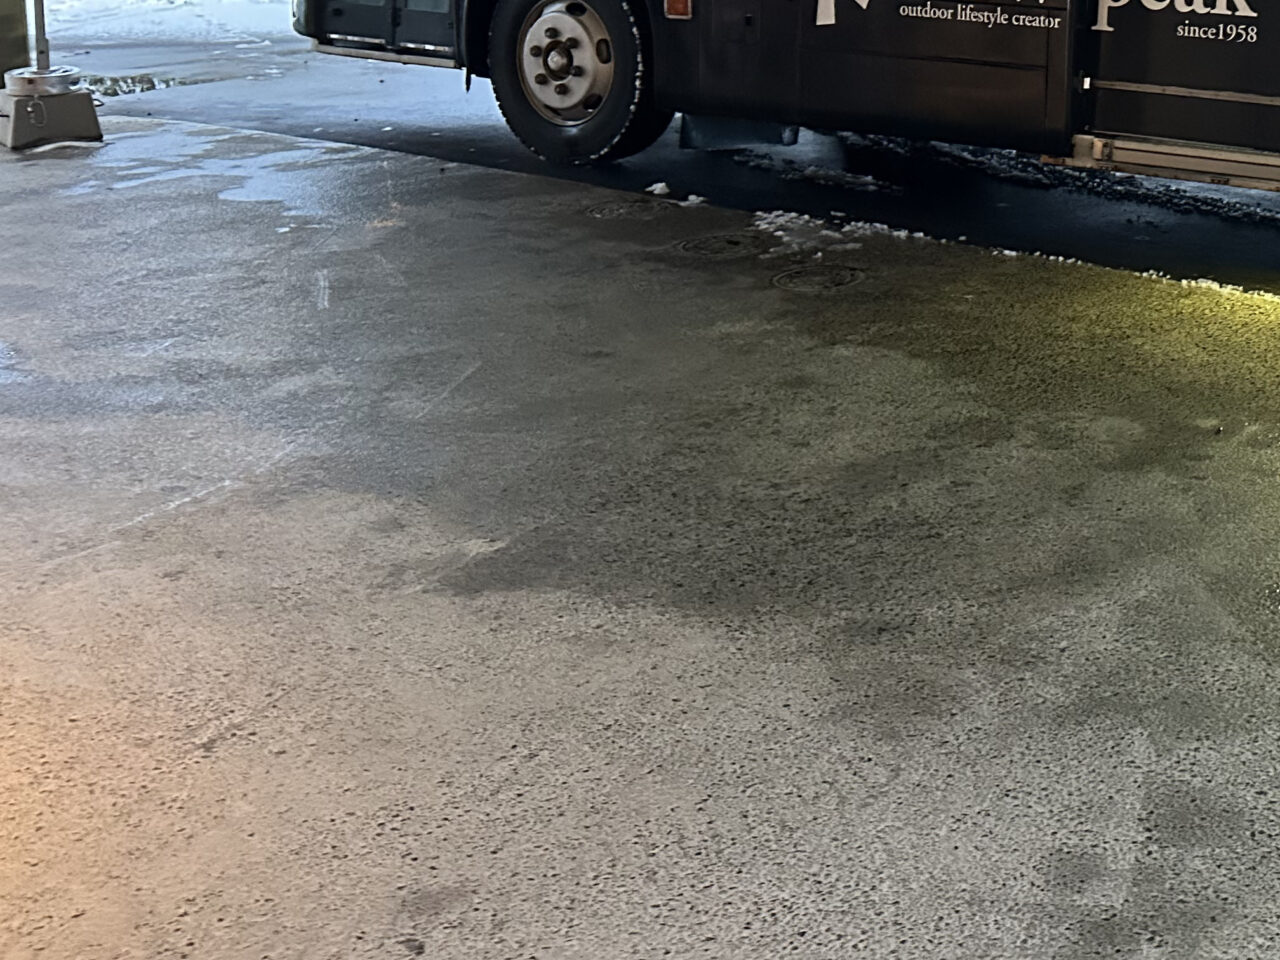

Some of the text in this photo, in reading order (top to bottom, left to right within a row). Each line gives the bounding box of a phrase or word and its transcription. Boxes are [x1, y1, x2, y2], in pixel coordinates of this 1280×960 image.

[899, 1, 1062, 30] outdoor lifestyle creator
[1175, 20, 1258, 43] since1958
